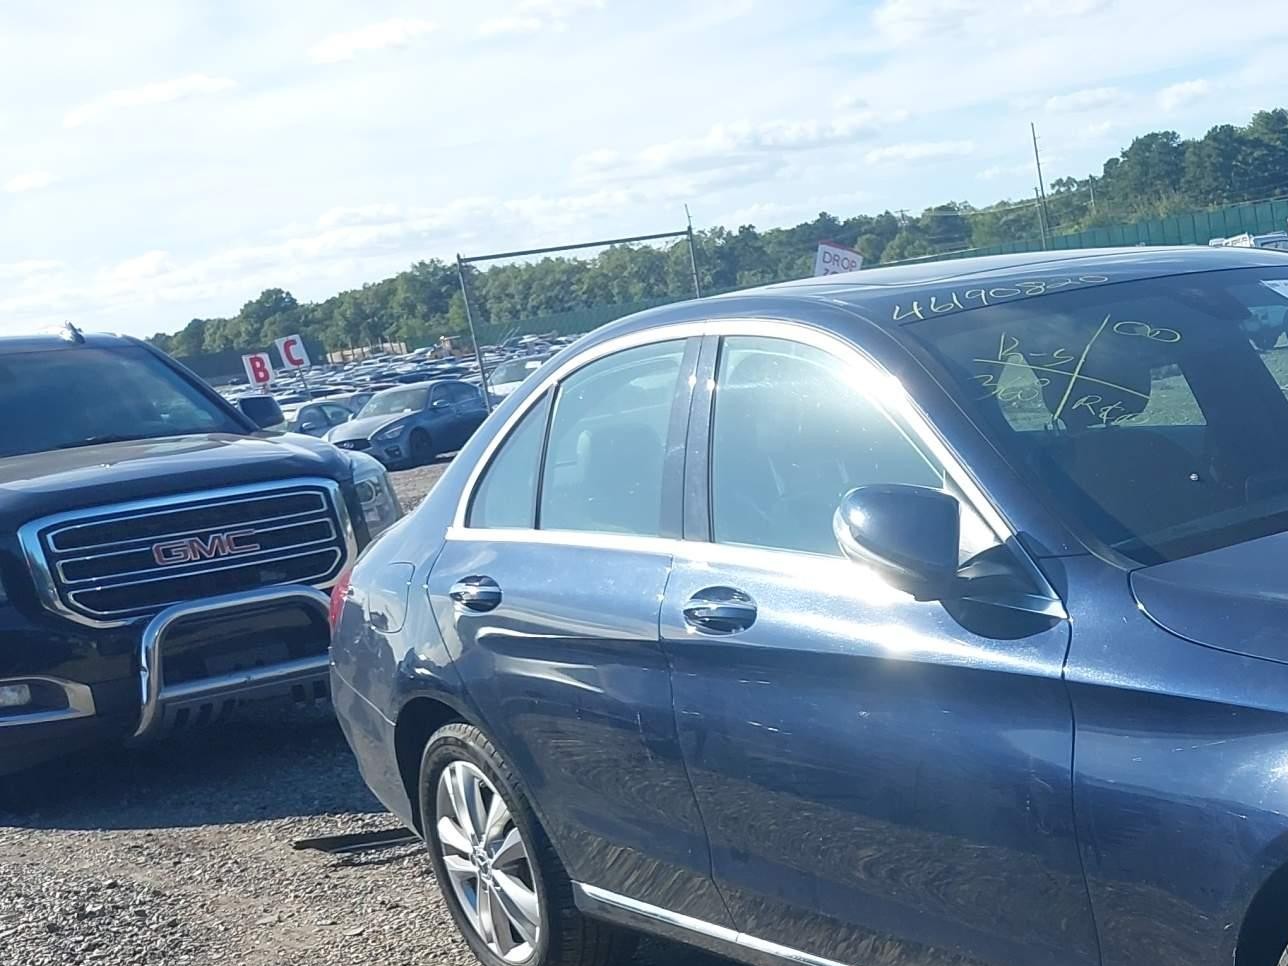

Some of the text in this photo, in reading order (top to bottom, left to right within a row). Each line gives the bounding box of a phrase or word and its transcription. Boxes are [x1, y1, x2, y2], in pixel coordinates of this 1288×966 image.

[822, 250, 857, 272] DROP
[893, 274, 1109, 321] 46190820
[283, 339, 305, 366] C
[248, 356, 270, 383] B
[152, 529, 261, 566] GMC
